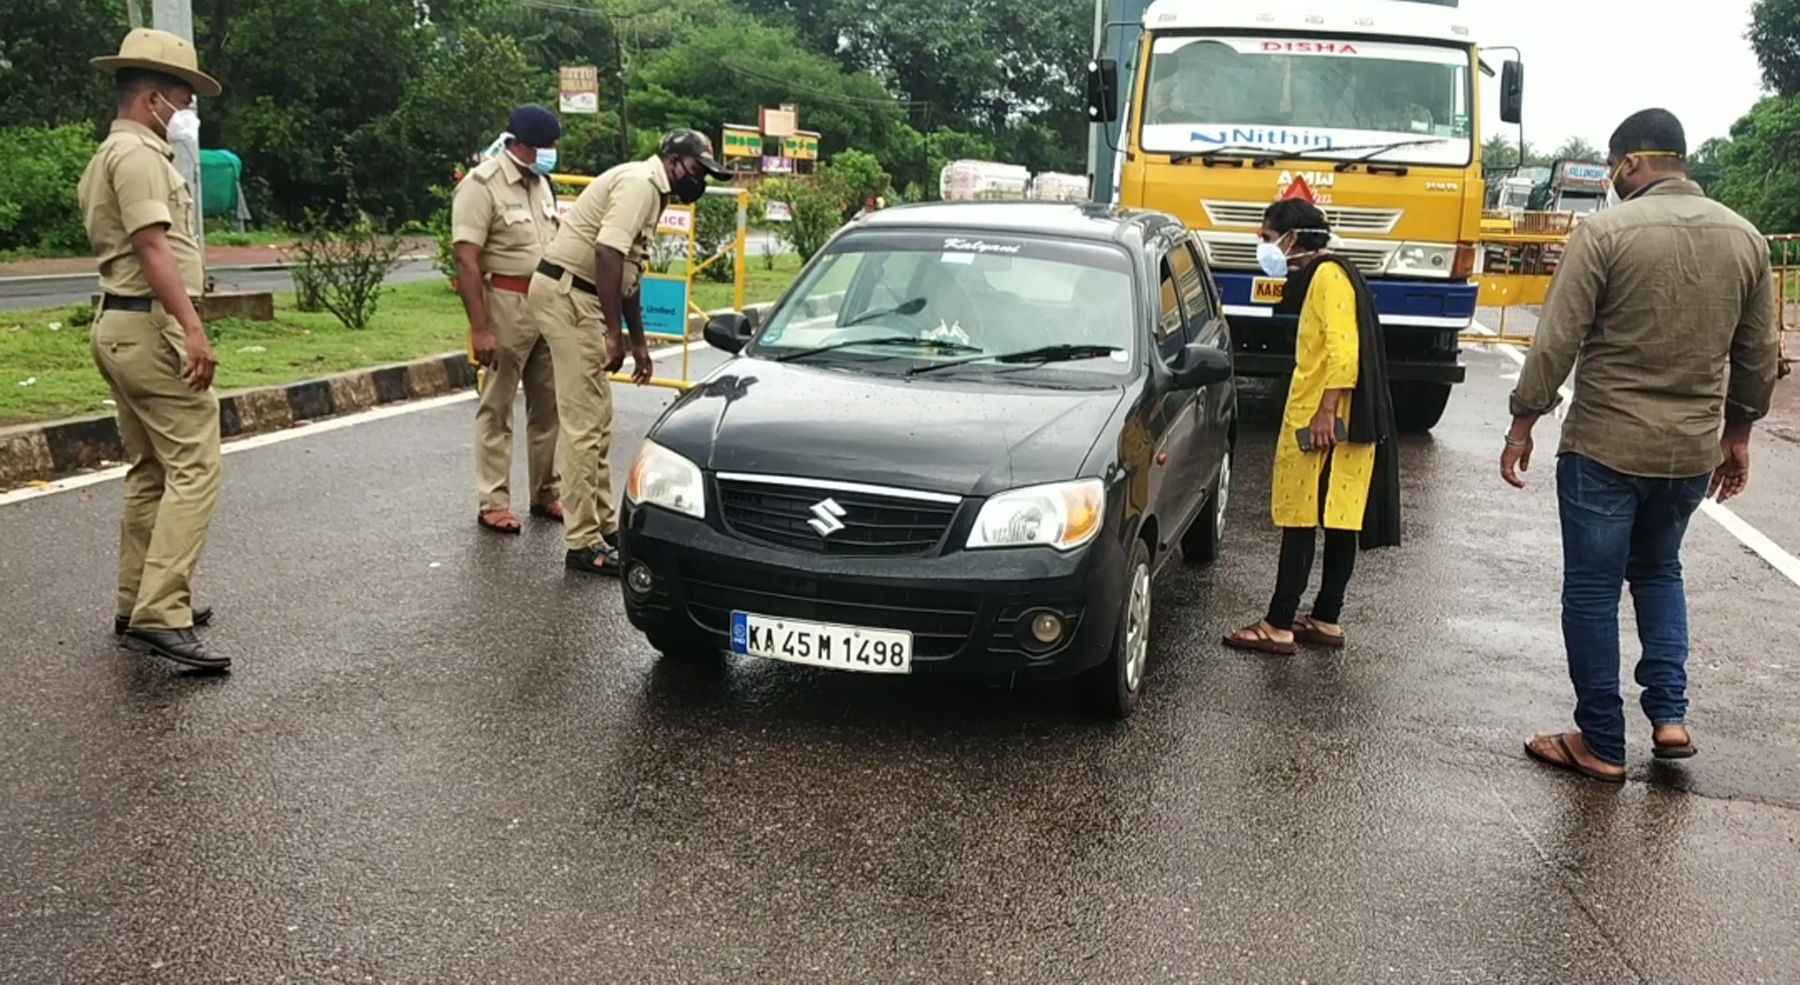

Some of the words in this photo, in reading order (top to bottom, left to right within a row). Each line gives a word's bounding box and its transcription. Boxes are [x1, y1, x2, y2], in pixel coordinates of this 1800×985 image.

[1261, 41, 1358, 55] DISHA
[1232, 128, 1333, 150] Nithin
[1277, 169, 1334, 188] AMW
[943, 237, 1021, 253] Kalyani
[748, 624, 775, 653] KA
[782, 630, 811, 657] 45
[817, 635, 831, 660] M
[843, 637, 904, 667] 1498
